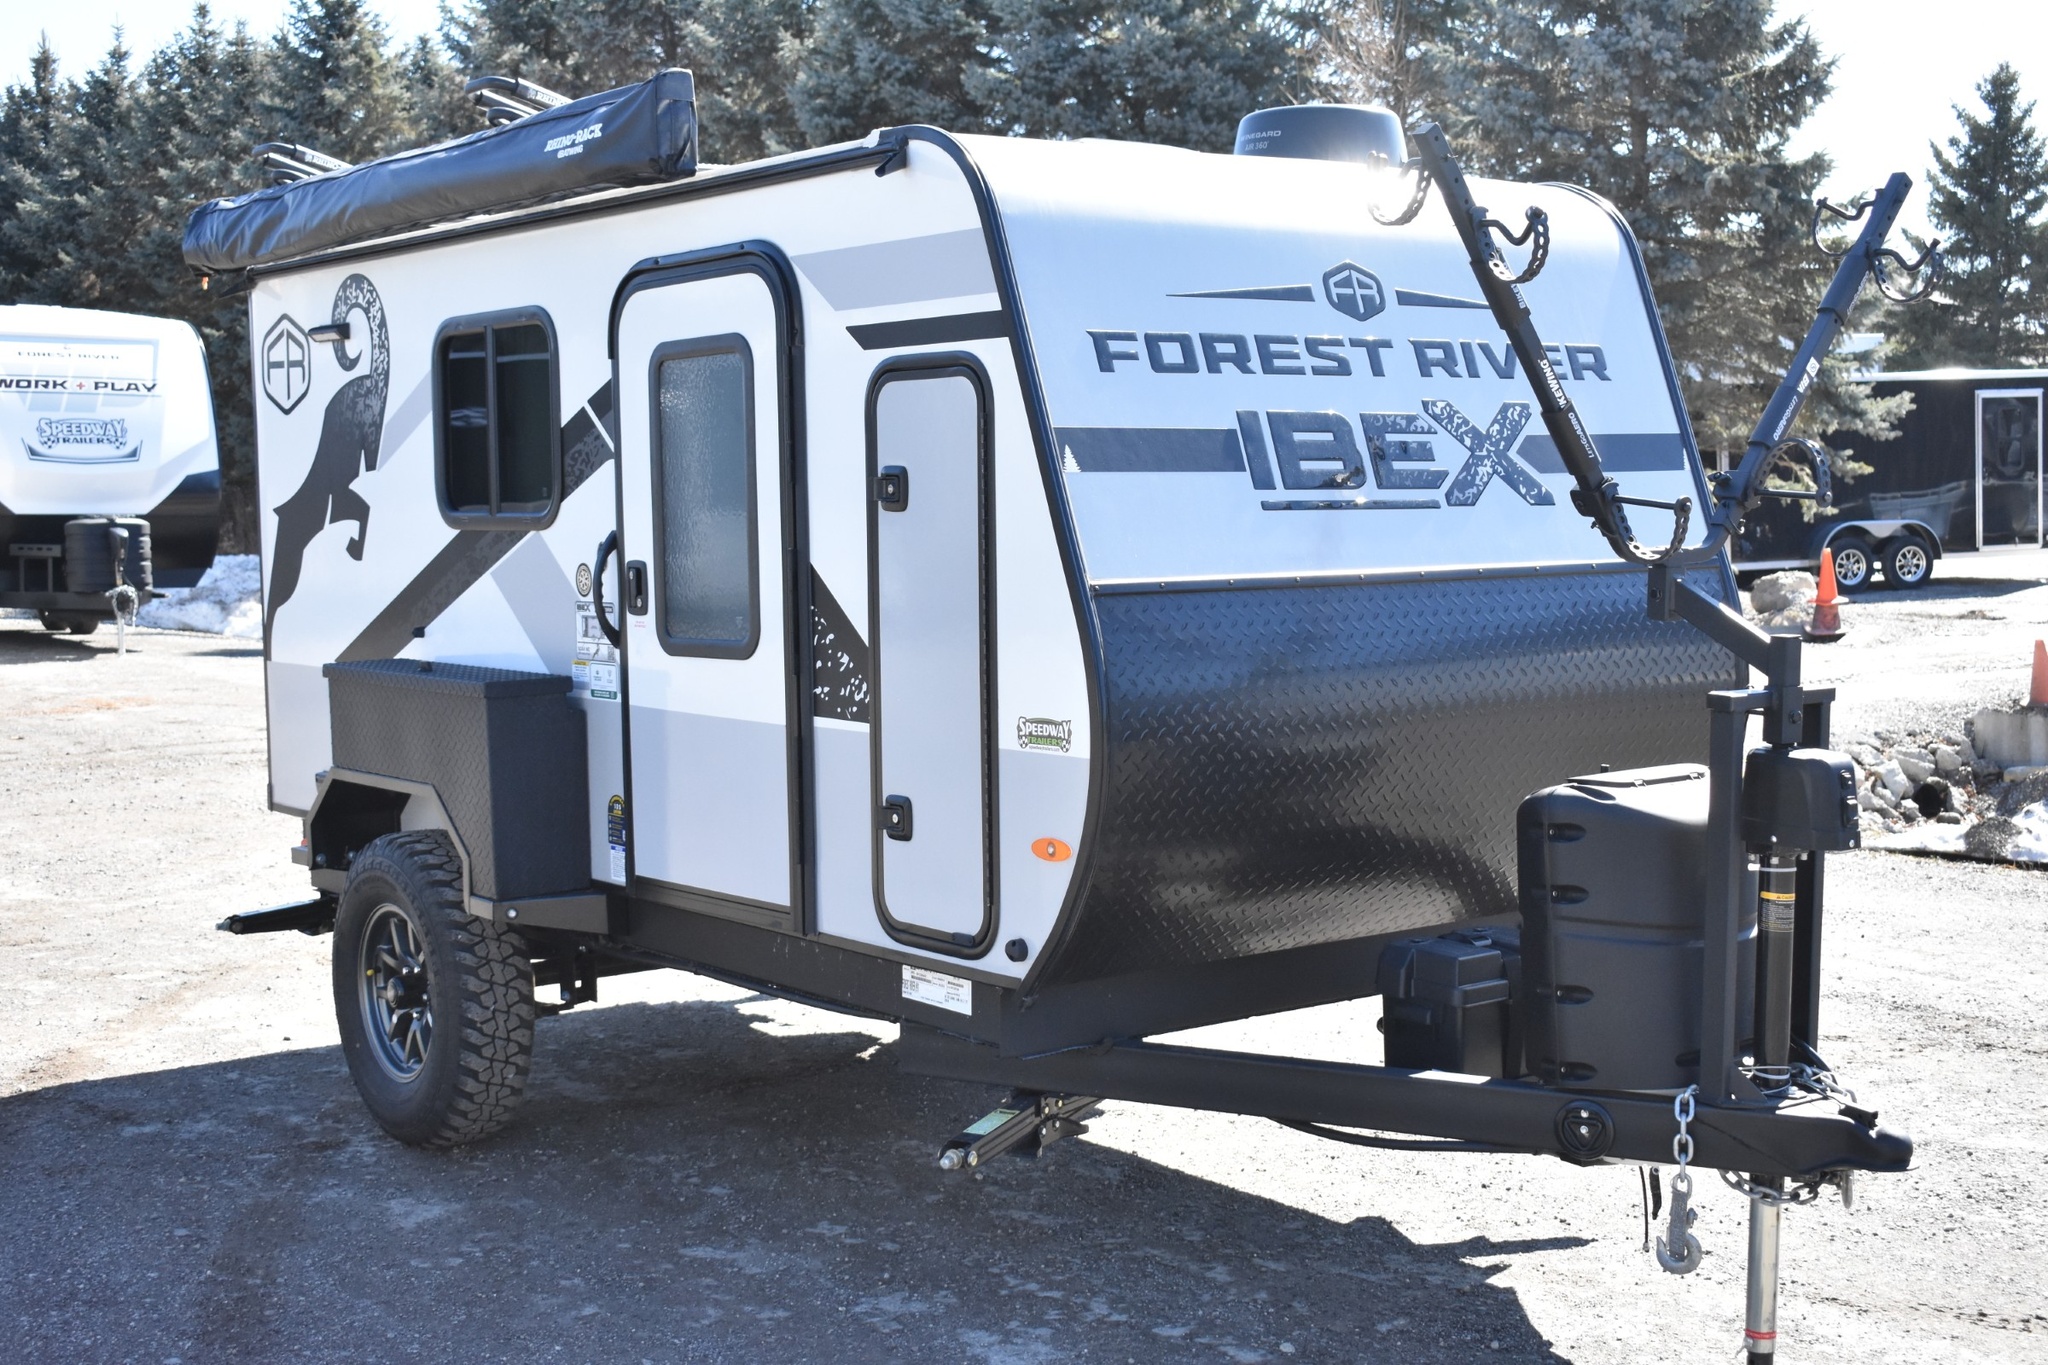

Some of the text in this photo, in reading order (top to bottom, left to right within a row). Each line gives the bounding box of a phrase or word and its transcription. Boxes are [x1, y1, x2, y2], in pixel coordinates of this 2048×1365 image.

[1240, 130, 1282, 142] WINEGARD
[1086, 329, 1612, 382] FOREST RIVER
[94, 380, 158, 393] PLAY
[38, 417, 126, 438] SPEEDWAY
[57, 437, 114, 445] TRAILERS
[1236, 398, 1556, 507] IBEX
[1018, 716, 1071, 741] SPEEDWAY
[1027, 735, 1063, 747] TRAILERS
